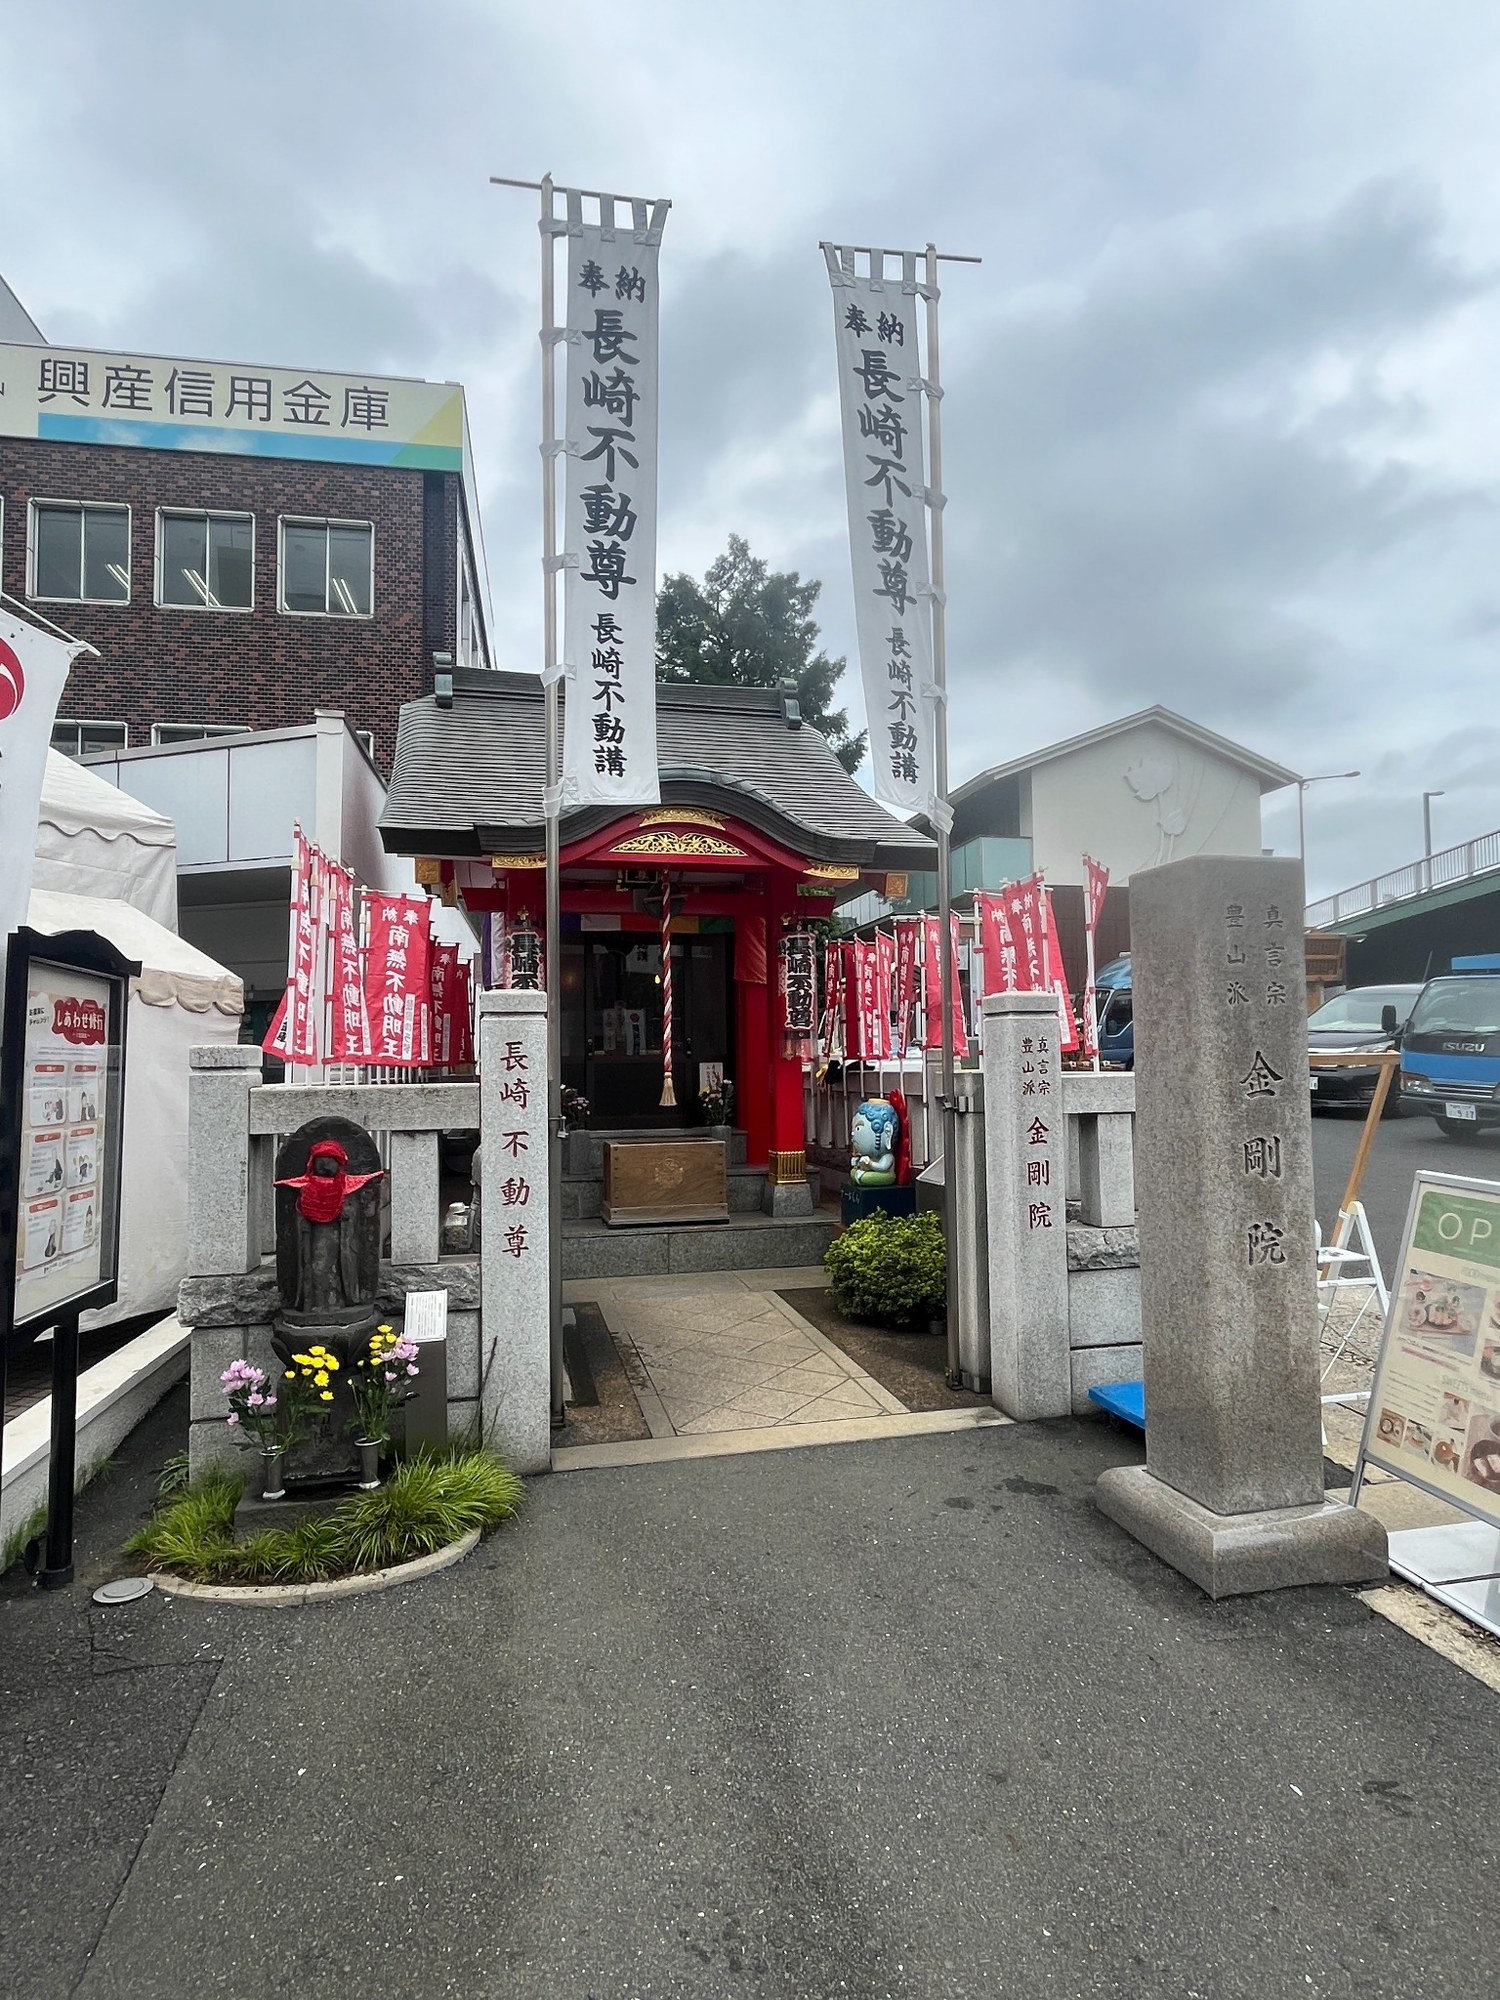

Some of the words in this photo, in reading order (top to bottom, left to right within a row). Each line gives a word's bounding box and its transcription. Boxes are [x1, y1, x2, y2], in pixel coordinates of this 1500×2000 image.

[578, 259, 646, 303] 奉納
[844, 304, 904, 347] 奉納
[37, 358, 390, 431] 興産信用金庫
[580, 309, 640, 601] 長崎不動尊
[853, 349, 917, 617] 長崎不動尊
[591, 613, 626, 778] 長崎不動講
[886, 627, 919, 784] 長崎不動講
[1225, 904, 1250, 1005] 豊山派
[1263, 904, 1286, 1006] 真言宗
[57, 1010, 103, 1031] しあわせ修行
[1022, 1037, 1037, 1095] 豊山派
[1037, 1036, 1051, 1094] 真言宗
[1443, 1042, 1487, 1053] ISUZU
[500, 1041, 531, 1258] 長崎不動尊
[1026, 1115, 1052, 1229] 金剛院
[1239, 1050, 1288, 1266] 金剛院
